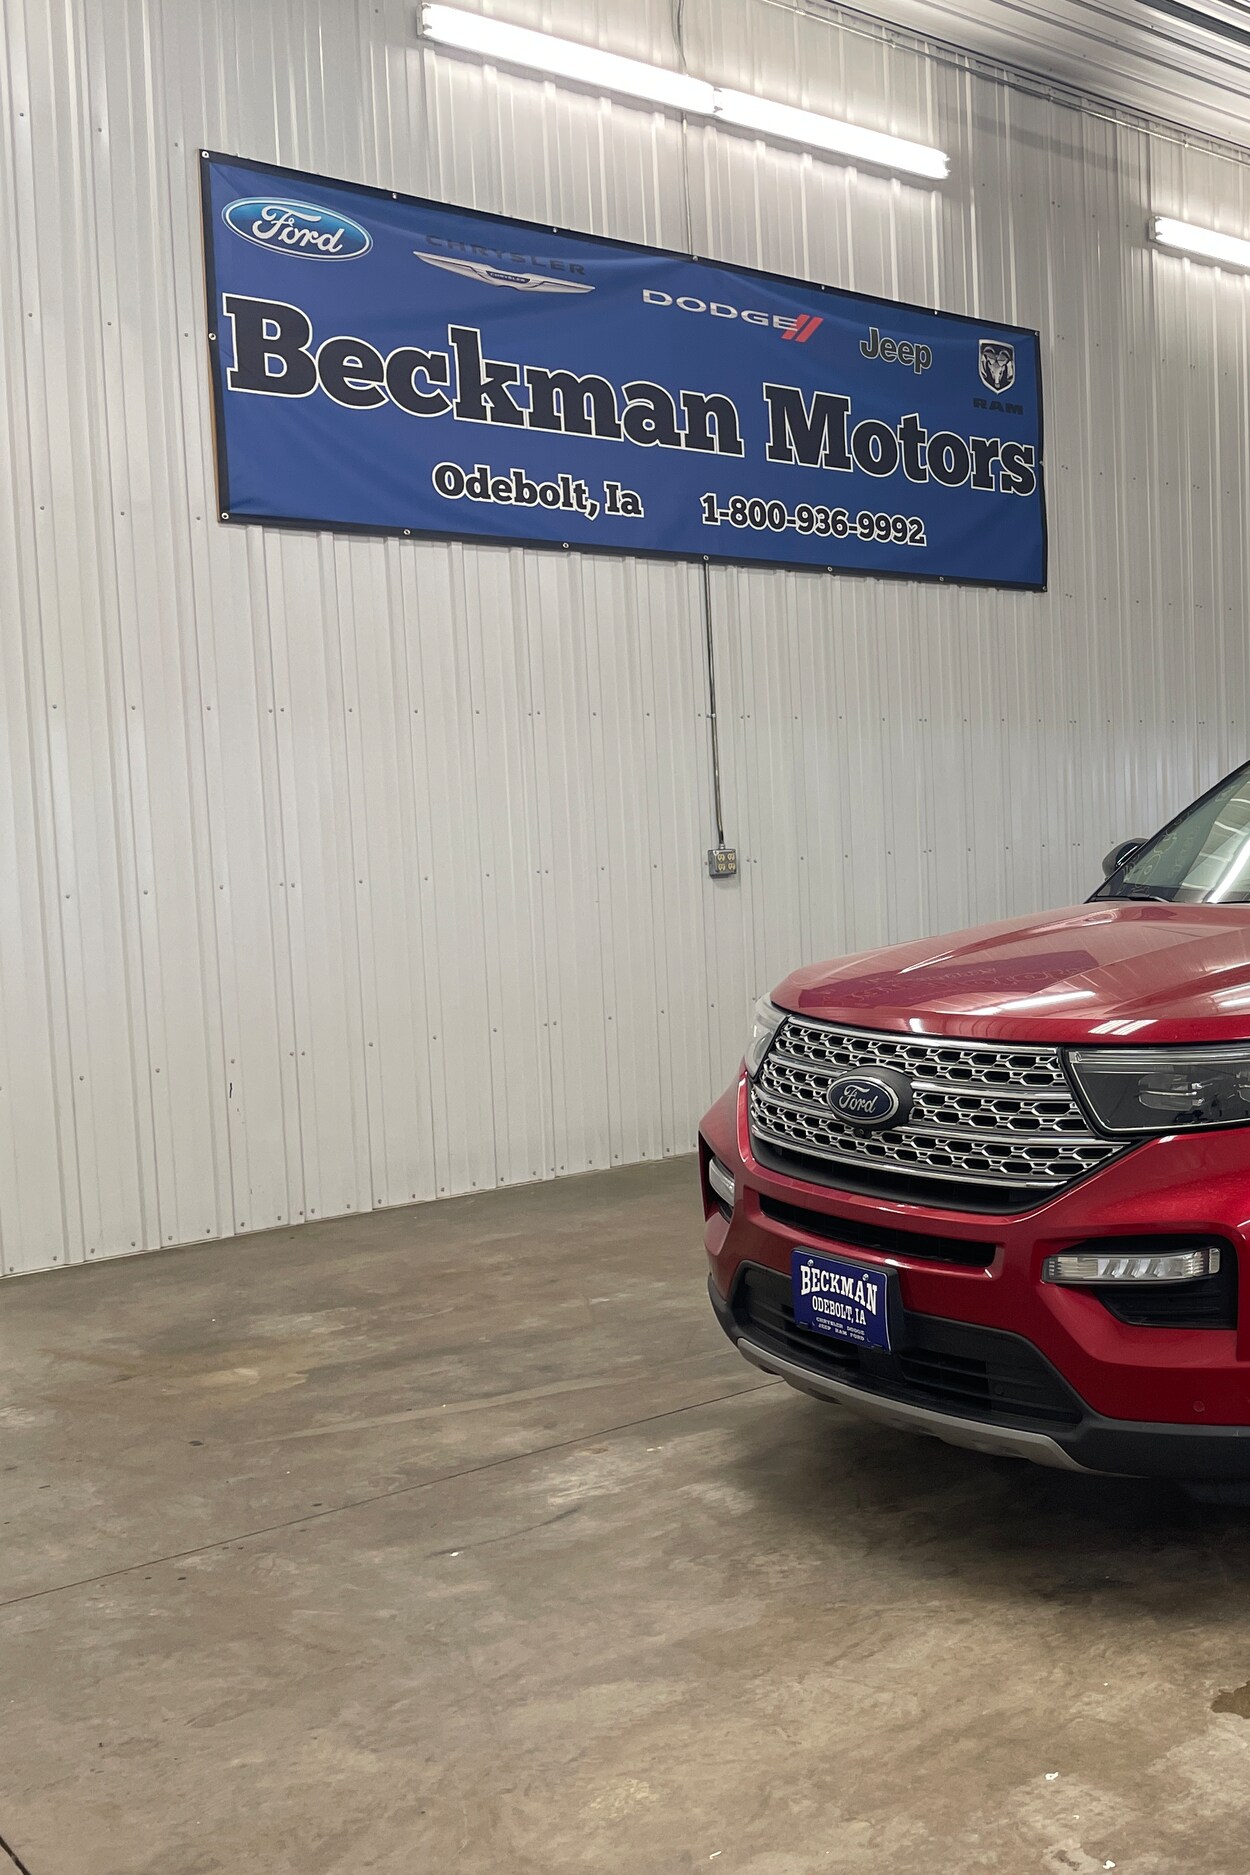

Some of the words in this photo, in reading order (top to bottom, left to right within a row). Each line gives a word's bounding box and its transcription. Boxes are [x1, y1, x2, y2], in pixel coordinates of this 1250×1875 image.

[251, 205, 344, 254] Ford
[425, 234, 586, 276] CHRYSLER
[641, 288, 801, 332] DODGE
[859, 326, 932, 374] Jeep
[222, 292, 745, 458] Beckman
[763, 381, 1037, 497] Motors
[972, 397, 1024, 416] RAM
[432, 461, 600, 521] Odebolt,
[603, 480, 644, 519] Ia
[700, 492, 927, 547] 1-800-936-9992
[839, 1084, 879, 1114] Ford
[800, 1265, 877, 1315] BECKMAN
[812, 1296, 853, 1323] ODEBOLT,
[855, 1308, 866, 1325] IA
